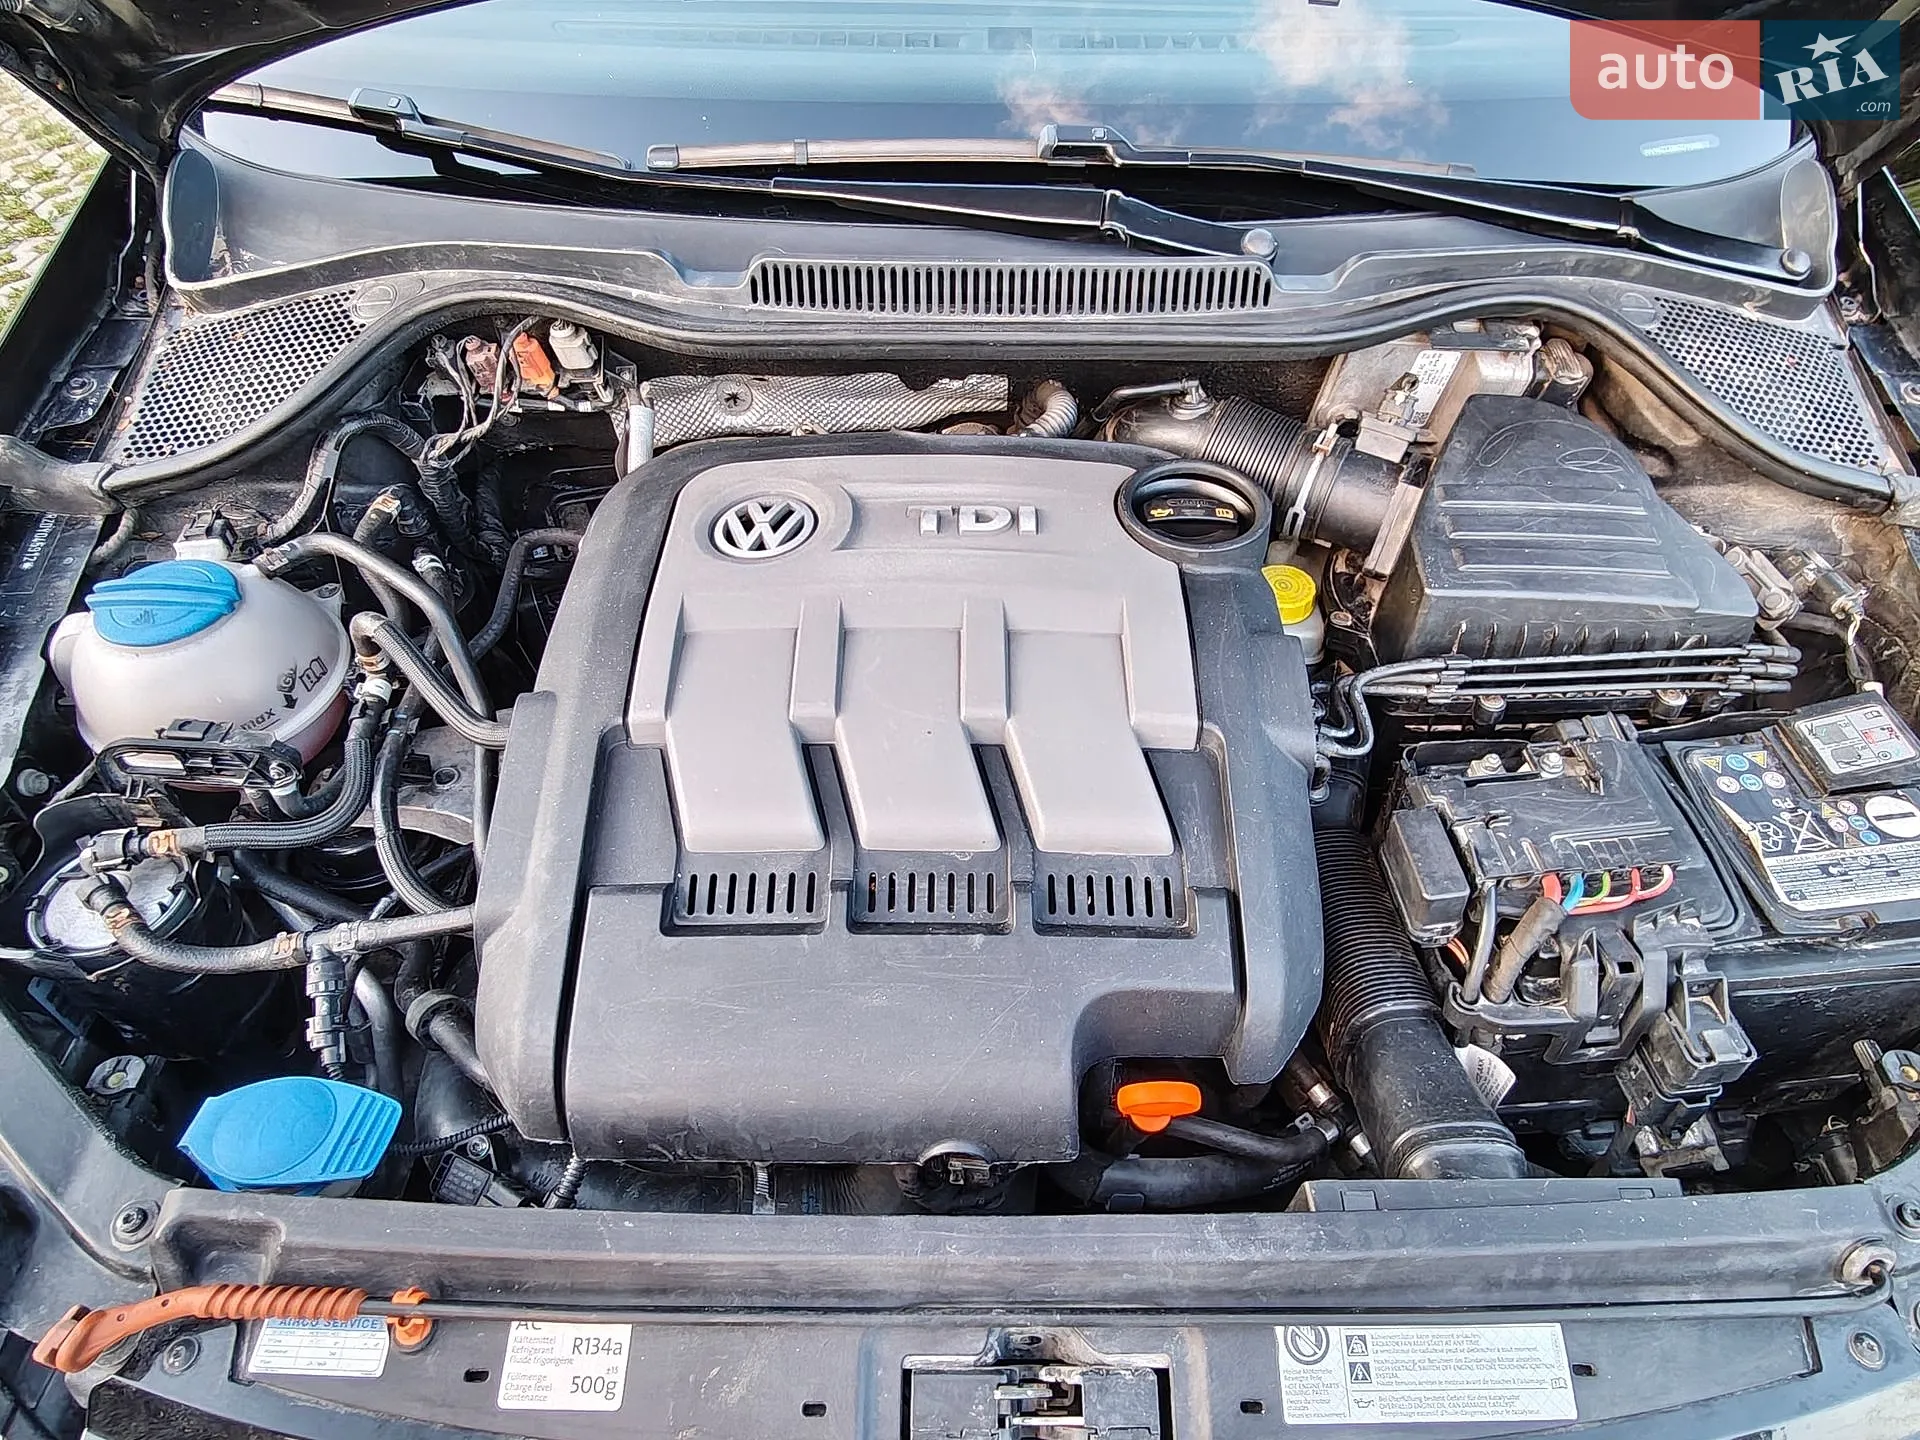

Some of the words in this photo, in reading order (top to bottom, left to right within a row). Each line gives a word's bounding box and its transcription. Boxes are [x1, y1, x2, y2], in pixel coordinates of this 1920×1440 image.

[905, 504, 1040, 536] TDI
[572, 1337, 623, 1355] R134a
[569, 1376, 618, 1400] 500g
